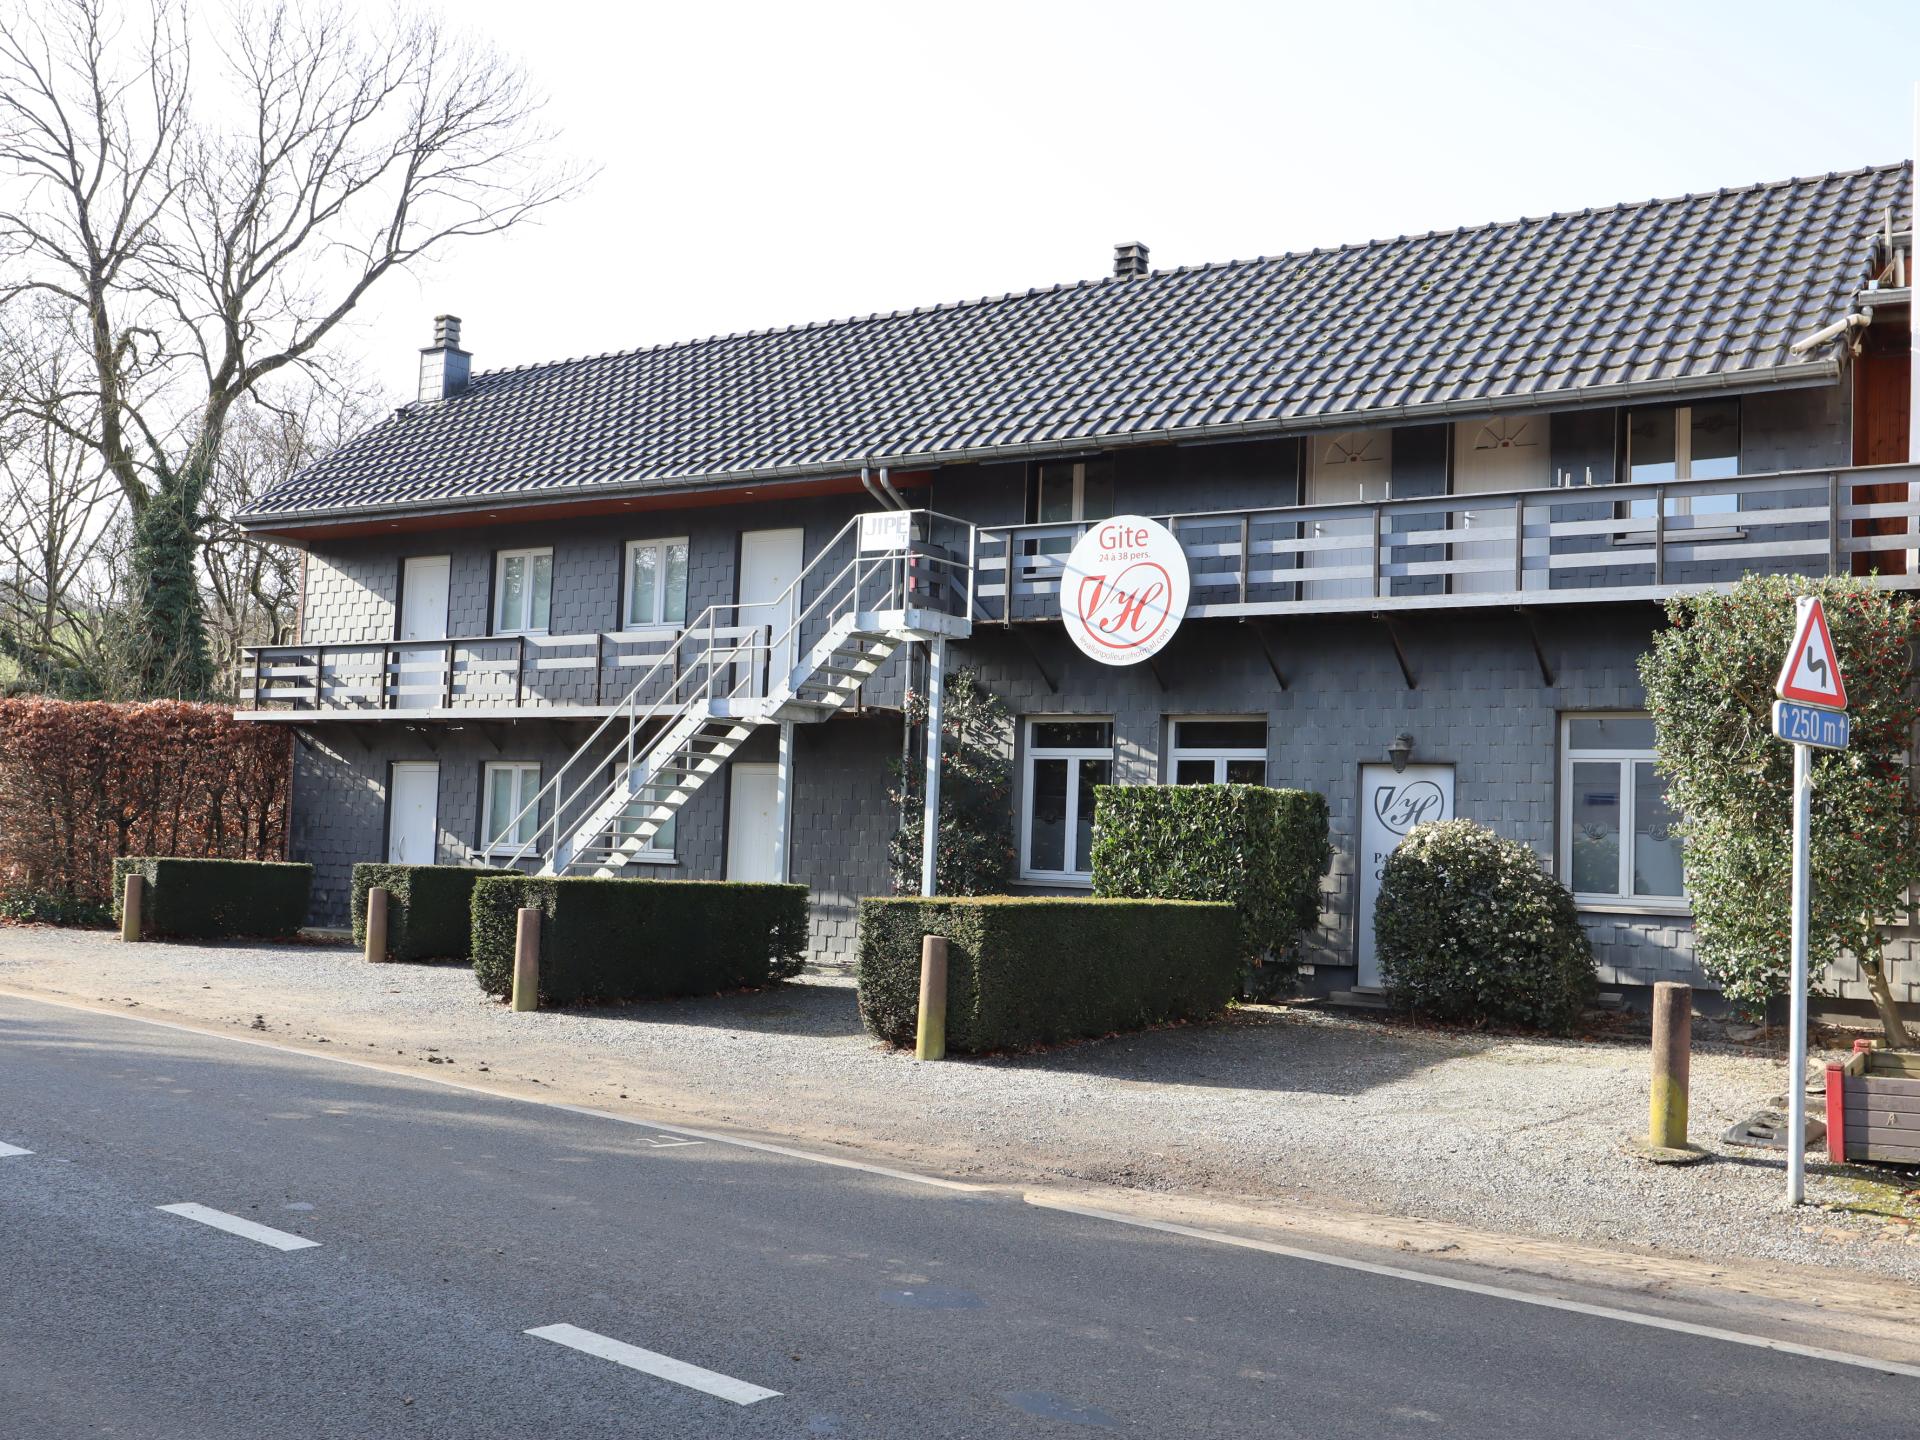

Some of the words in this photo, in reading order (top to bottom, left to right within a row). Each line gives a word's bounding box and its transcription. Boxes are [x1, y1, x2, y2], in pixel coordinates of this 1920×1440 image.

[1099, 525, 1149, 550] Gite
[1099, 553, 1109, 562] 24
[1118, 552, 1128, 560] 38
[1130, 552, 1151, 561] pers.
[1791, 708, 1820, 741] 250
[1824, 720, 1836, 743] m
